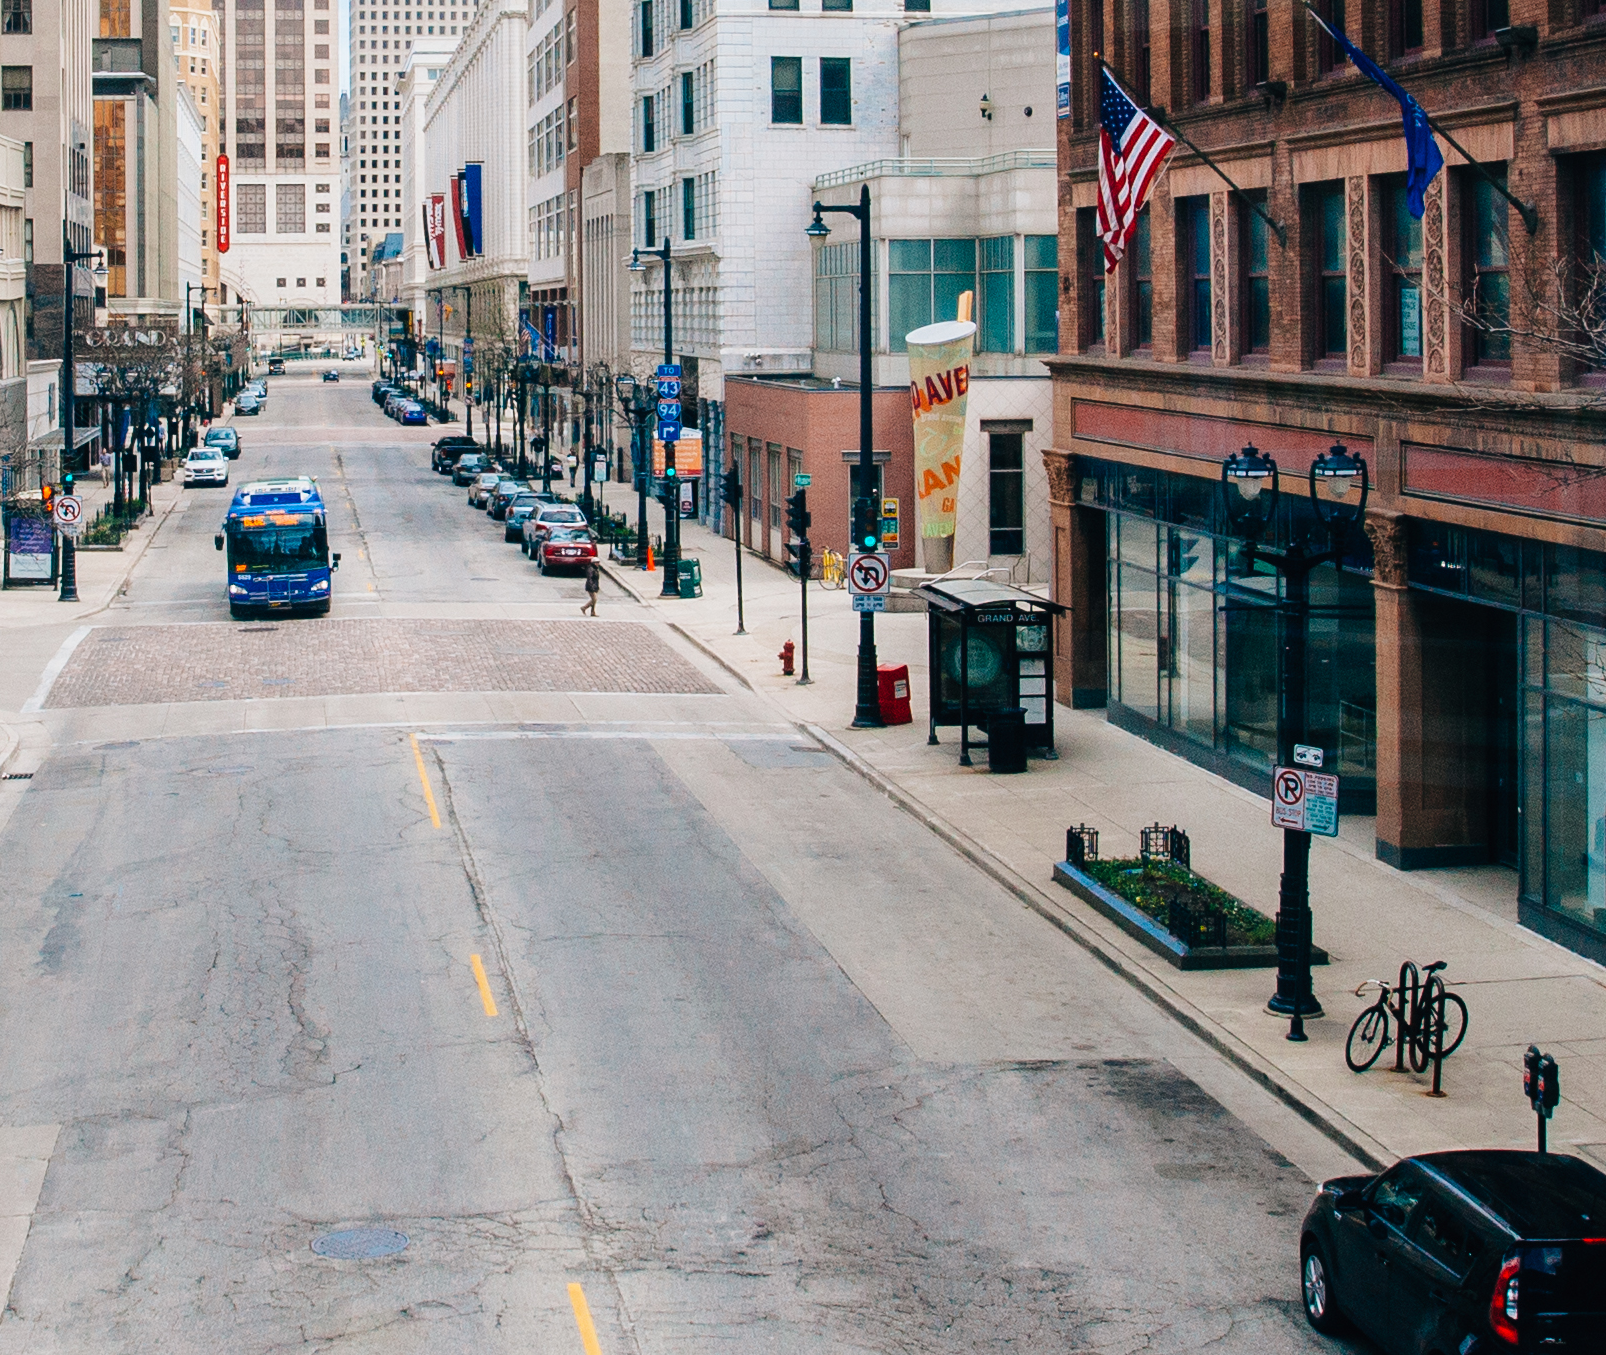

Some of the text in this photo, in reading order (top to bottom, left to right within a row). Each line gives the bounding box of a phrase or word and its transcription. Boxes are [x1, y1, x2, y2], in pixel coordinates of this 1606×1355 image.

[219, 164, 227, 244] RIVERSIDE
[85, 330, 166, 347] GRAND
[660, 381, 678, 394] 43
[659, 404, 677, 416] 94
[918, 454, 961, 499] AN
[977, 613, 1040, 623] GRAND AVE.
[1276, 806, 1302, 817] BUS STOP
